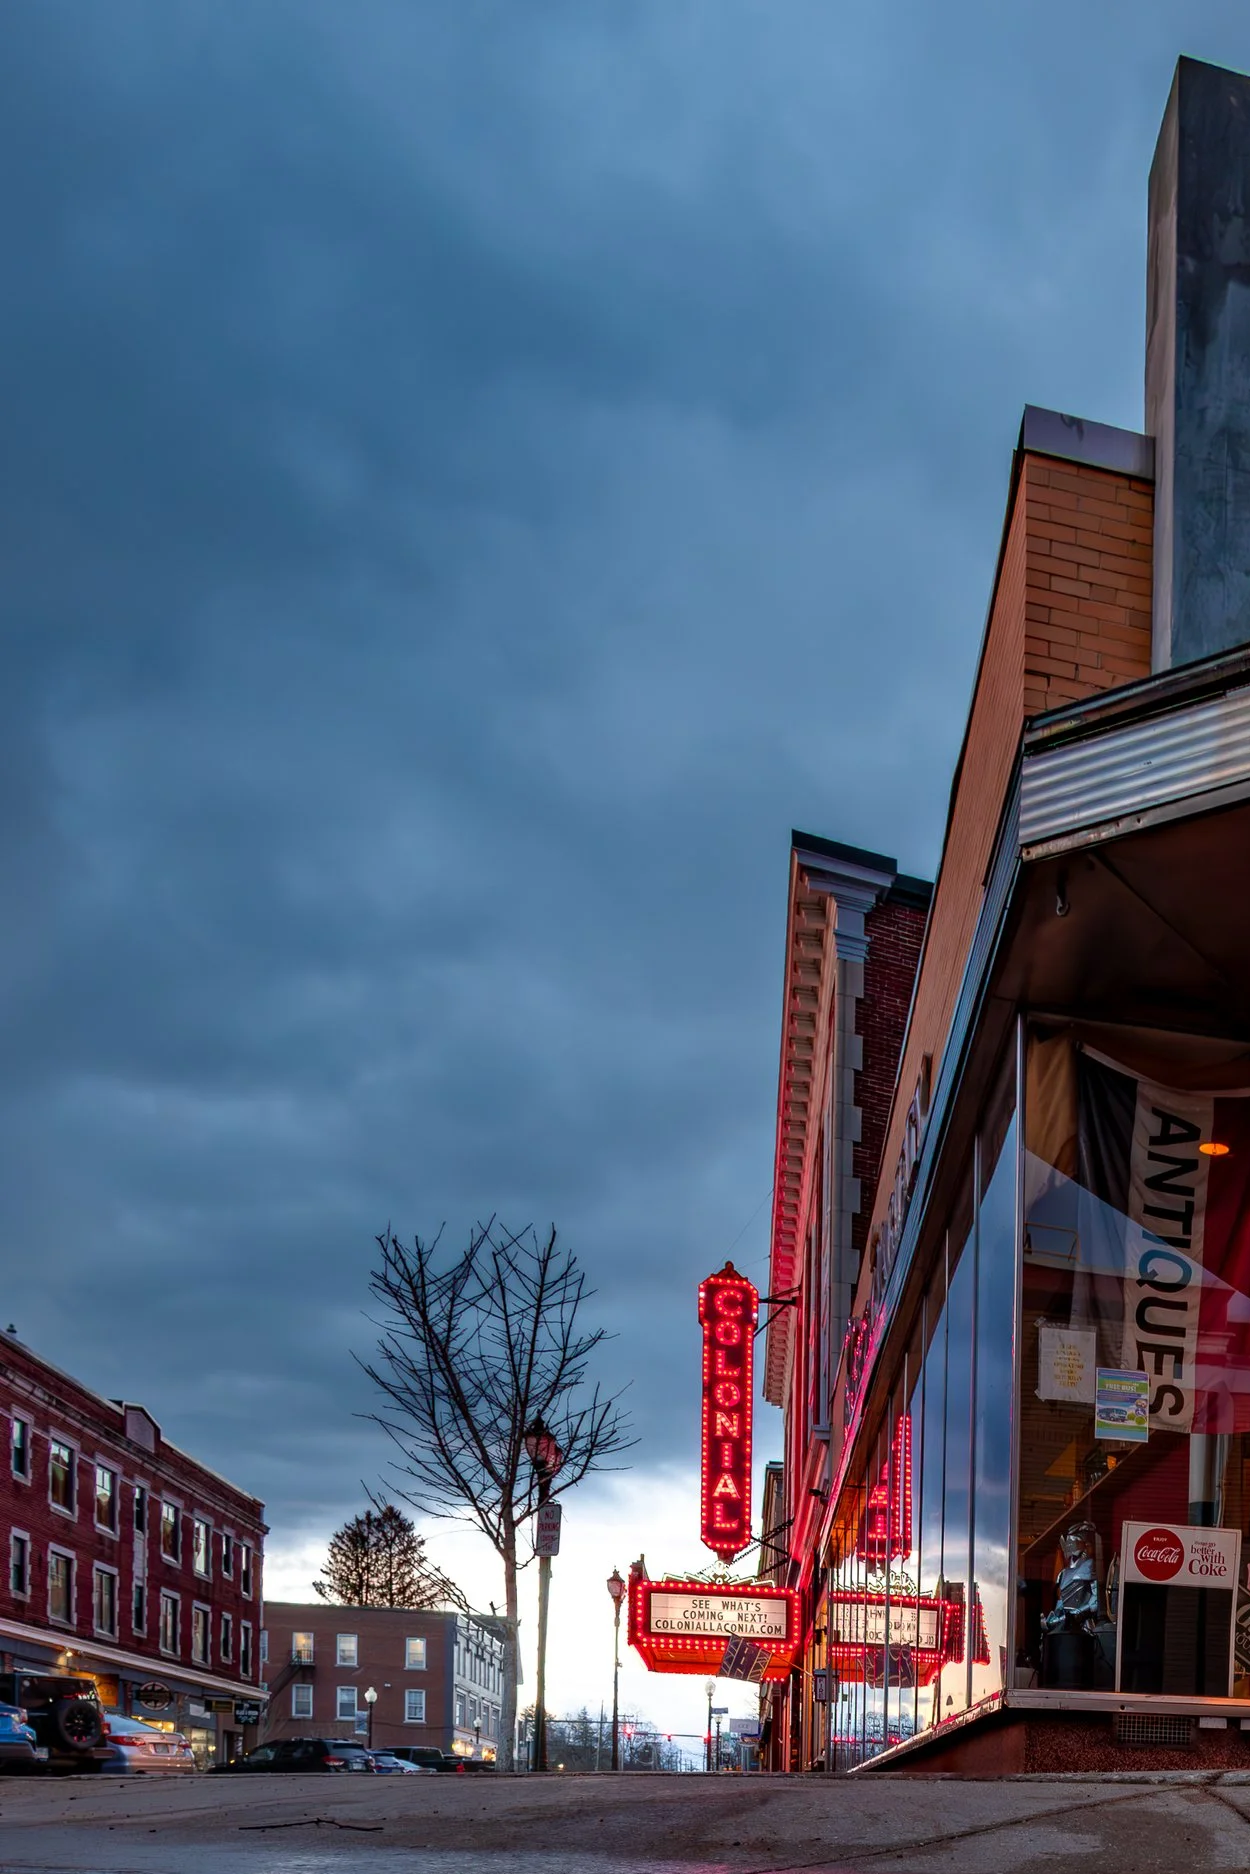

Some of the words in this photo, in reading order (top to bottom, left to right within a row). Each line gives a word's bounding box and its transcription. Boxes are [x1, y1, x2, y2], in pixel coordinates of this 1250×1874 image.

[1134, 1105, 1203, 1418] ANTIQUES
[712, 1289, 744, 1531] COLONIAL
[1136, 1545, 1181, 1564] Coca-Cola
[1190, 1544, 1216, 1555] better
[1200, 1551, 1225, 1565] with
[1188, 1558, 1228, 1577] Coke
[691, 1599, 711, 1610] SEE
[721, 1600, 762, 1612] WHAT'S
[682, 1609, 724, 1621] COMING
[737, 1612, 768, 1624] NEXT!
[654, 1619, 783, 1636] COLONIALLACONIA.COM
